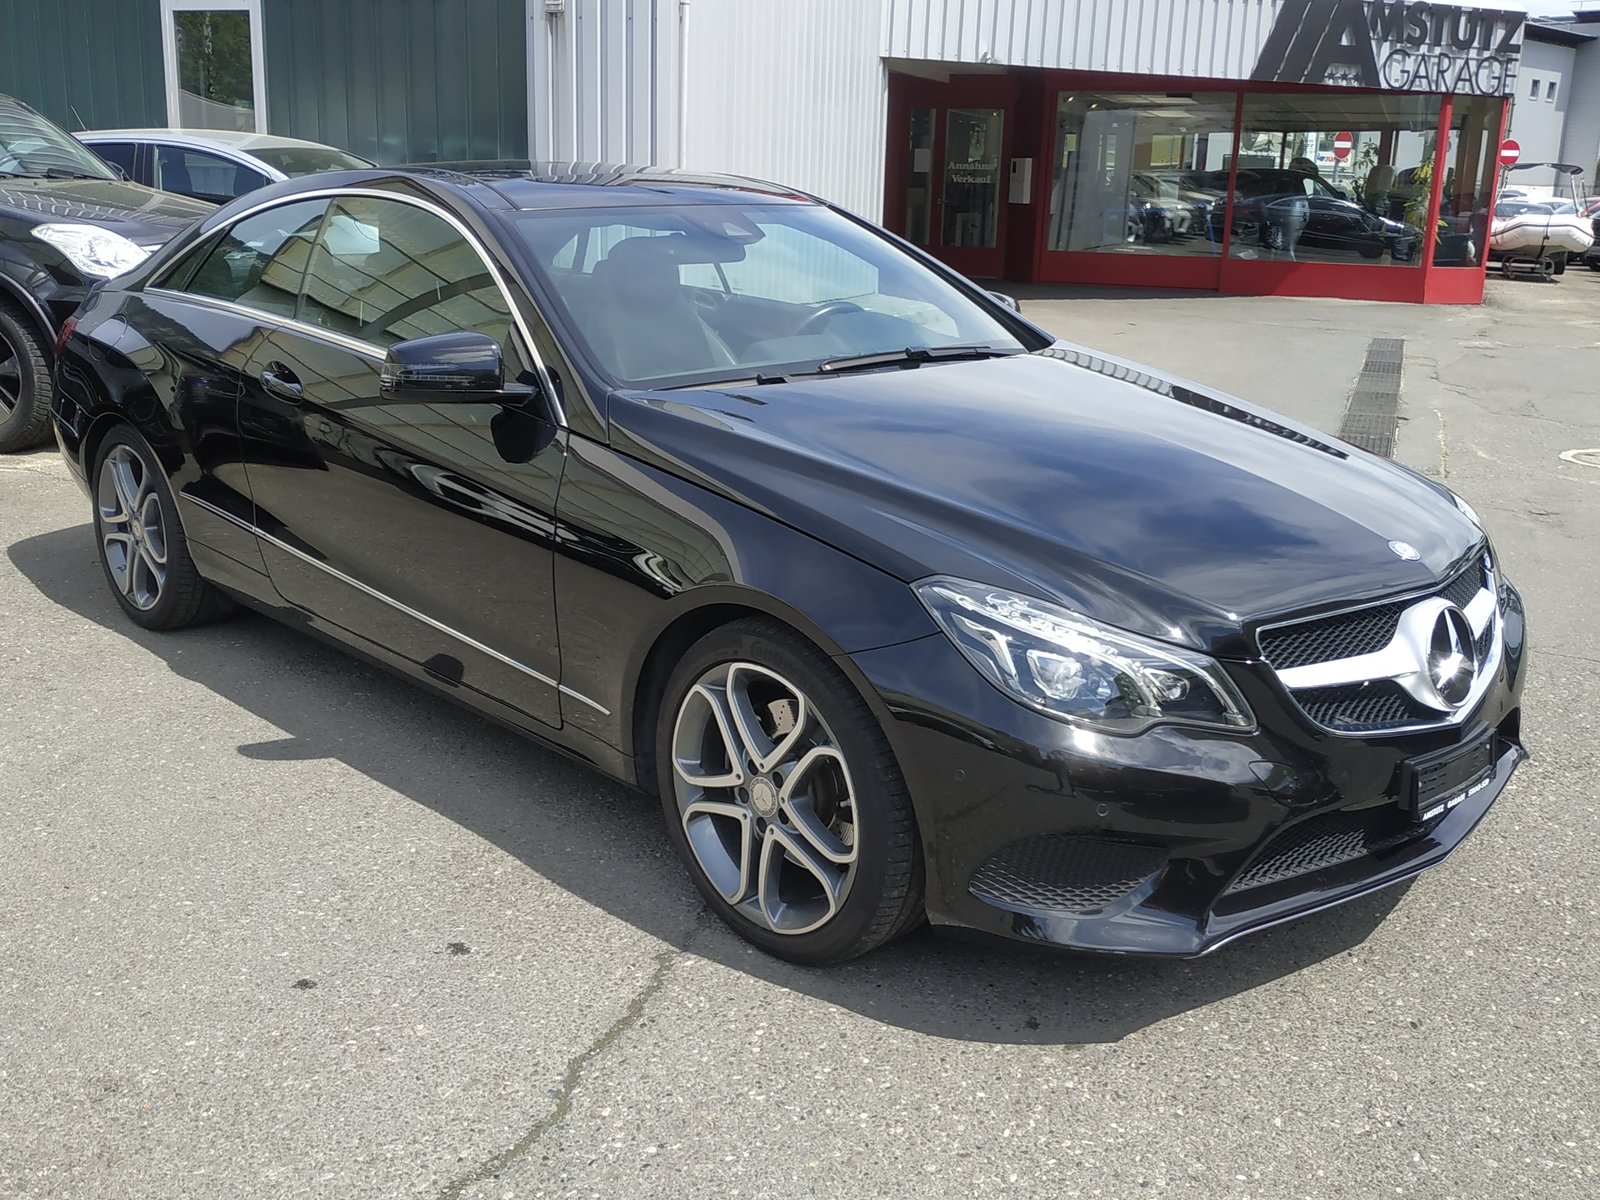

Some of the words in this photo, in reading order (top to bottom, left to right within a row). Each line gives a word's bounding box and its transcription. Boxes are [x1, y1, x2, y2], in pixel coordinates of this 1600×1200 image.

[1252, 0, 1527, 88] AMSTUTZ
[1383, 48, 1519, 96] GARAGE
[951, 174, 991, 184] Verkauf
